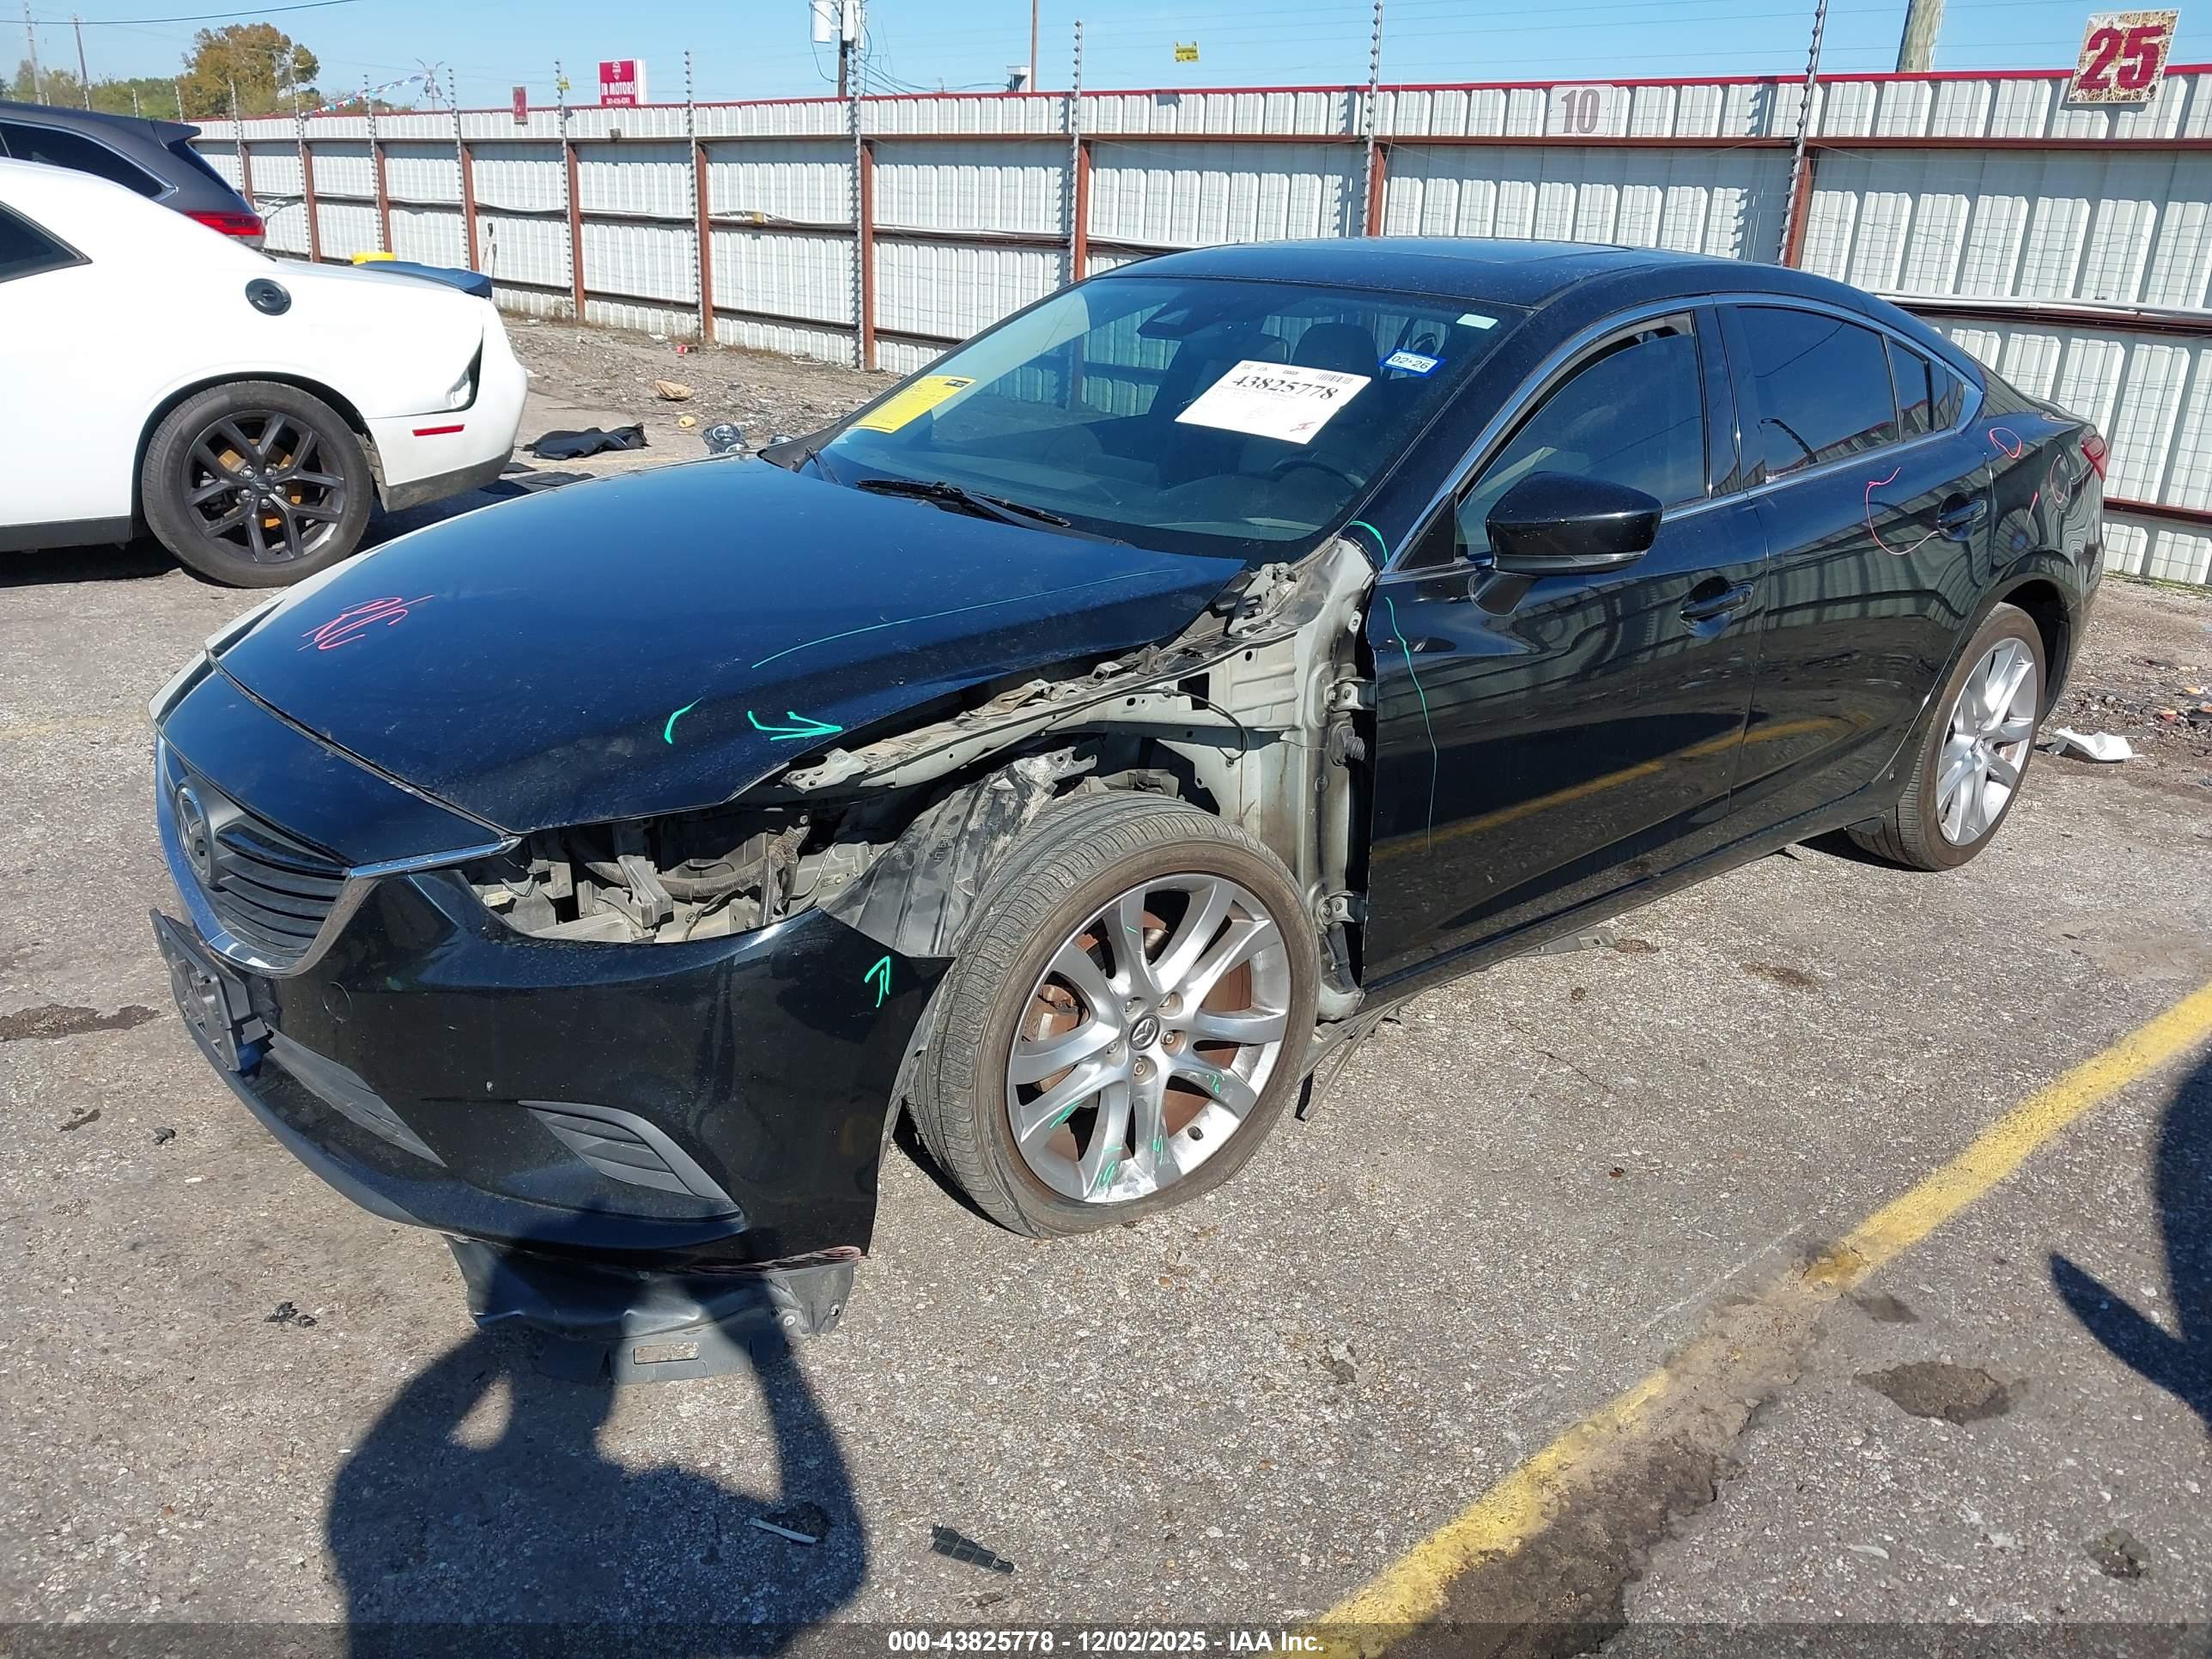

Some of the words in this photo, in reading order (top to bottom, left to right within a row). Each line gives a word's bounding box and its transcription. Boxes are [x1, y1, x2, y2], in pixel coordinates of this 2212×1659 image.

[2078, 27, 2164, 89] 25
[609, 81, 635, 95] MOTORS
[1561, 88, 1601, 134] 10
[1232, 375, 1339, 400] 43825778
